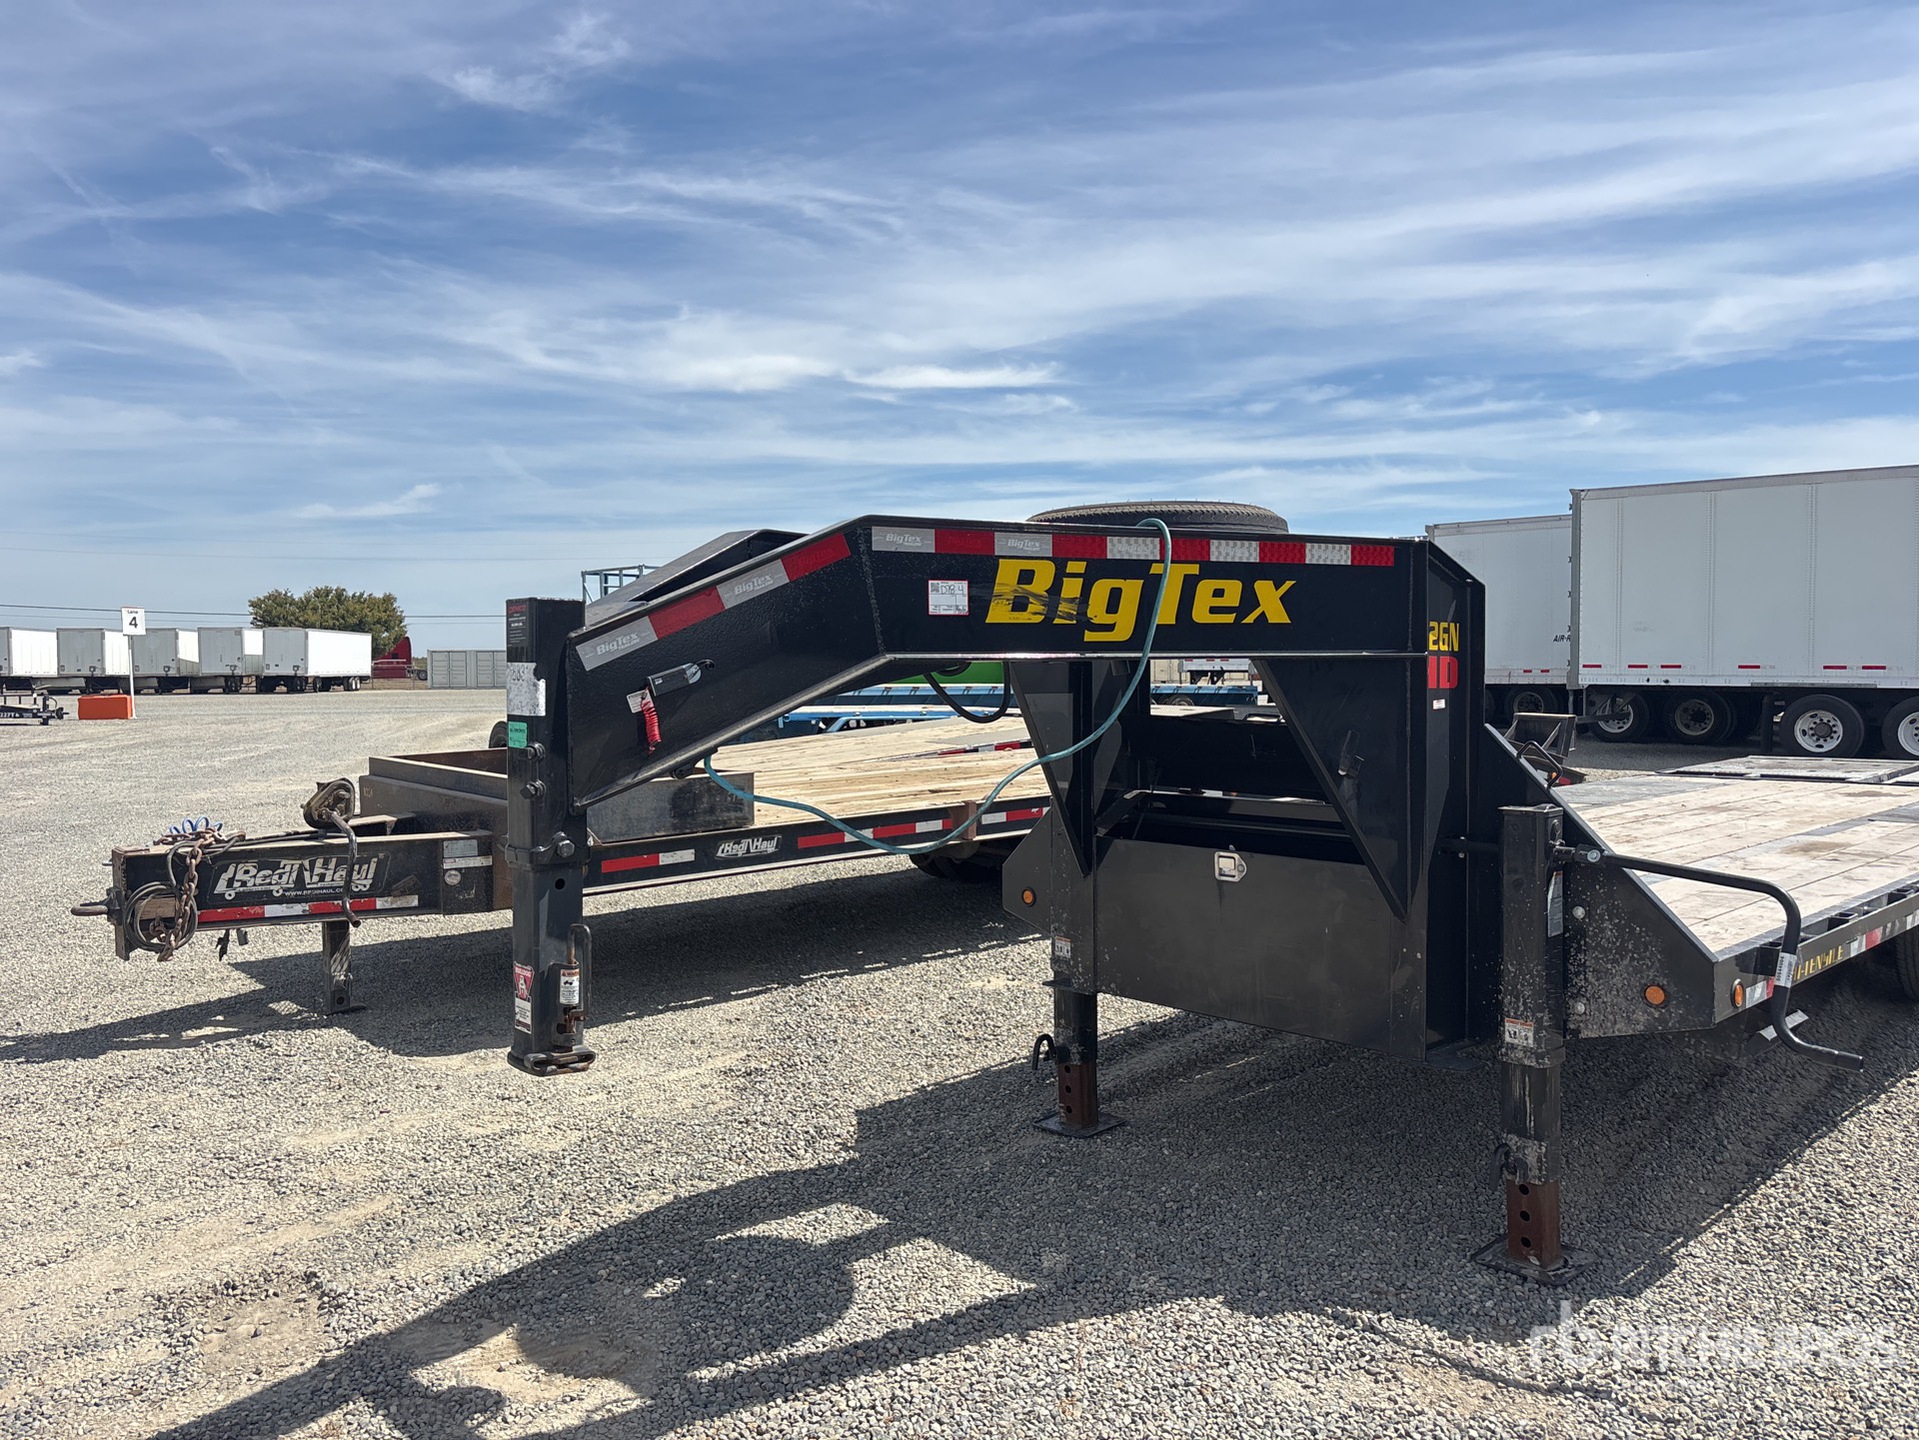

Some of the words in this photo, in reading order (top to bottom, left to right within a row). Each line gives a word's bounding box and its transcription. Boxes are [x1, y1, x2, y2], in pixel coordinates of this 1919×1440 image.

[886, 533, 921, 545] BigTex
[1008, 539, 1040, 549] BigTex
[734, 574, 772, 595] BigTex
[985, 558, 1297, 642] BigTex
[128, 616, 138, 629] 4
[597, 632, 638, 655] BigTex
